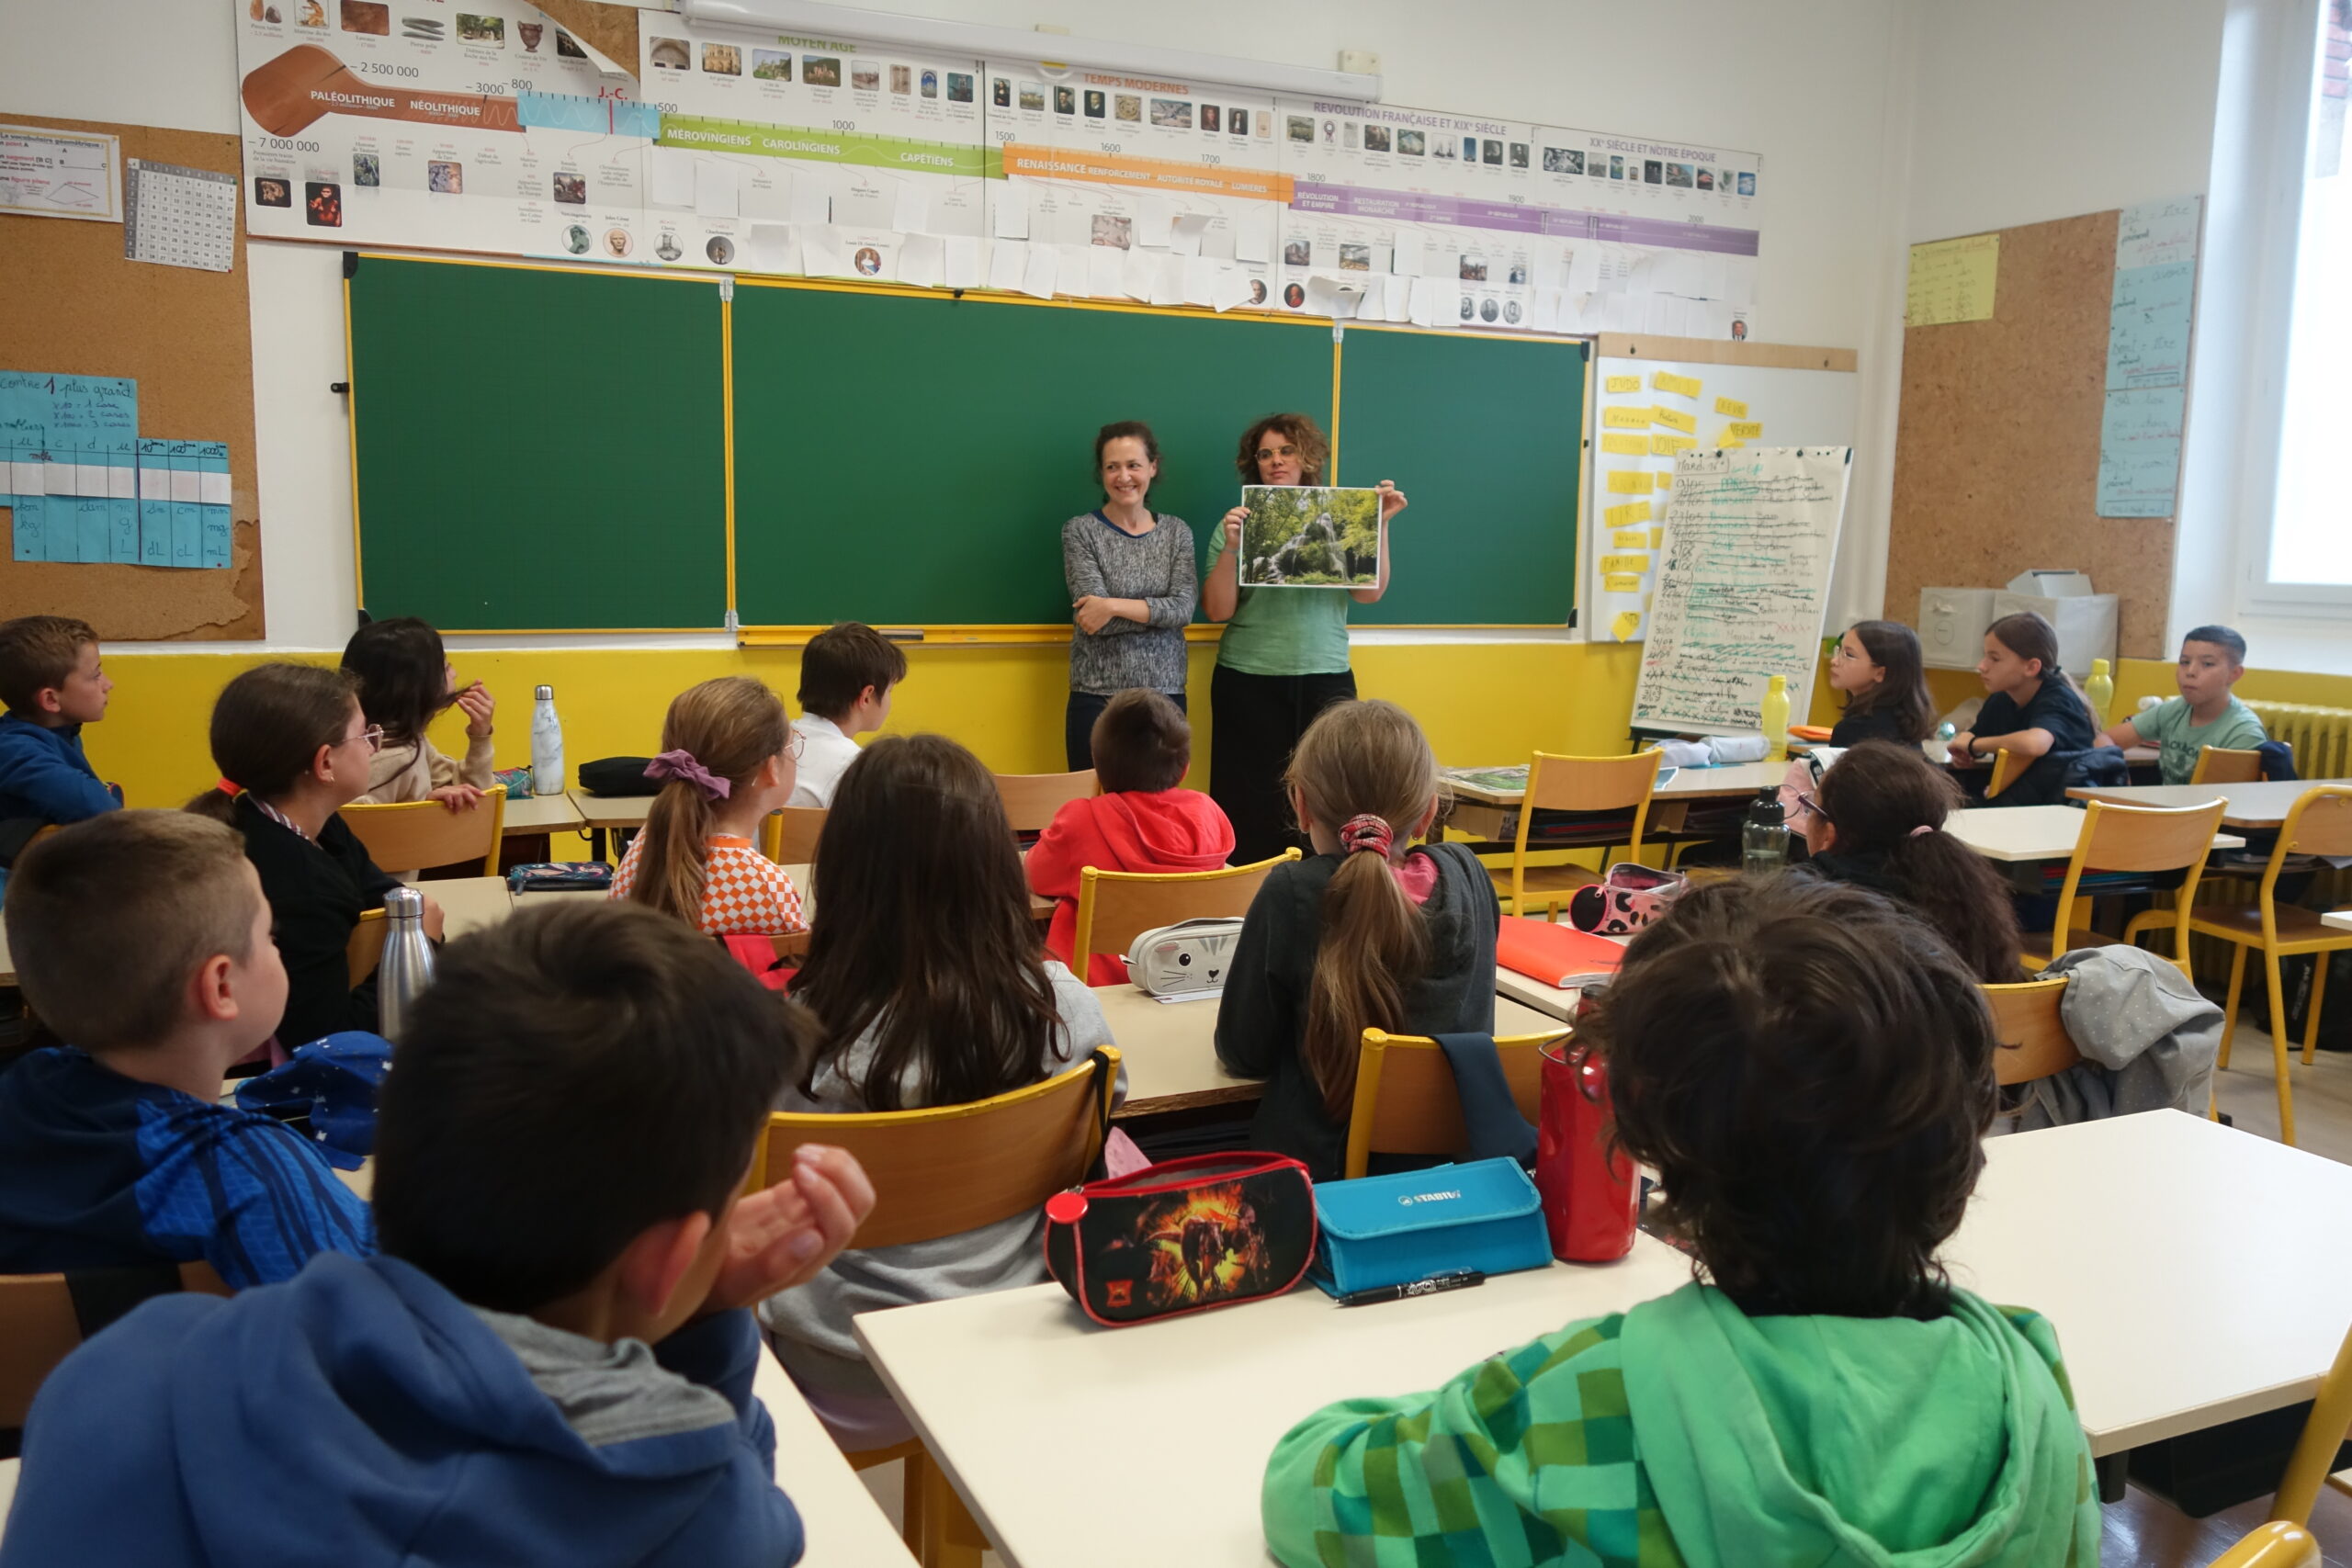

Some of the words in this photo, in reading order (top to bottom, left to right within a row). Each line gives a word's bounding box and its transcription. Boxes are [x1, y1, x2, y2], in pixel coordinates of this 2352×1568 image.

[778, 35, 826, 51] MOYEN
[361, 62, 368, 72] 2
[372, 63, 393, 74] 500
[397, 66, 420, 77] 000
[476, 83, 504, 95] 3000
[512, 79, 532, 89] 800
[1084, 73, 1122, 88] TEMPS
[1125, 79, 1189, 95] MODERNES
[311, 90, 395, 108] PALÉOLITHIQUE
[410, 100, 481, 117] NÉOLITHIQUE
[658, 102, 678, 114] 500
[833, 120, 855, 132] 1000
[1382, 111, 1438, 128] FRANÇAISE
[1440, 118, 1452, 129] ET
[1475, 121, 1507, 136] SIÈCLE
[10, 134, 52, 144] vocabulaire
[55, 139, 100, 149] géométrique
[996, 130, 1016, 142] 1500
[260, 137, 267, 148] 7
[270, 139, 293, 150] 000
[297, 141, 320, 152] 000
[668, 129, 752, 148] MÉROVINGIENS
[763, 141, 841, 159] CAROLINGIENS
[900, 152, 955, 168] CAPÉTIENS
[1101, 142, 1121, 153] 1600
[1607, 139, 1636, 152] SIÈCLE
[1637, 143, 1648, 154] ET
[1650, 144, 1679, 158] NOTRE
[1680, 146, 1717, 163] ÉPOQUE
[1201, 153, 1220, 164] 1700
[1017, 158, 1086, 175] RENAISSANCE
[1088, 167, 1151, 182] RENFORCEMENT
[1195, 177, 1224, 189] ROYALE
[1306, 173, 1326, 183] 1800
[1297, 191, 1339, 203] RÉVOLUTION
[1509, 194, 1525, 204] 1900
[1302, 200, 1310, 209] ET
[1311, 201, 1335, 210] EMPIRE
[1688, 214, 1705, 224] 2000
[44, 376, 55, 395] 1
[60, 378, 88, 398] plus
[94, 384, 133, 402] grand
[87, 436, 96, 450] d
[1610, 503, 1649, 527] LIRE
[17, 513, 41, 538] kg
[119, 516, 132, 536] g
[207, 523, 230, 537] mg
[120, 538, 133, 554] L
[147, 540, 165, 557] dL
[176, 543, 194, 558] cL
[206, 545, 228, 558] mL
